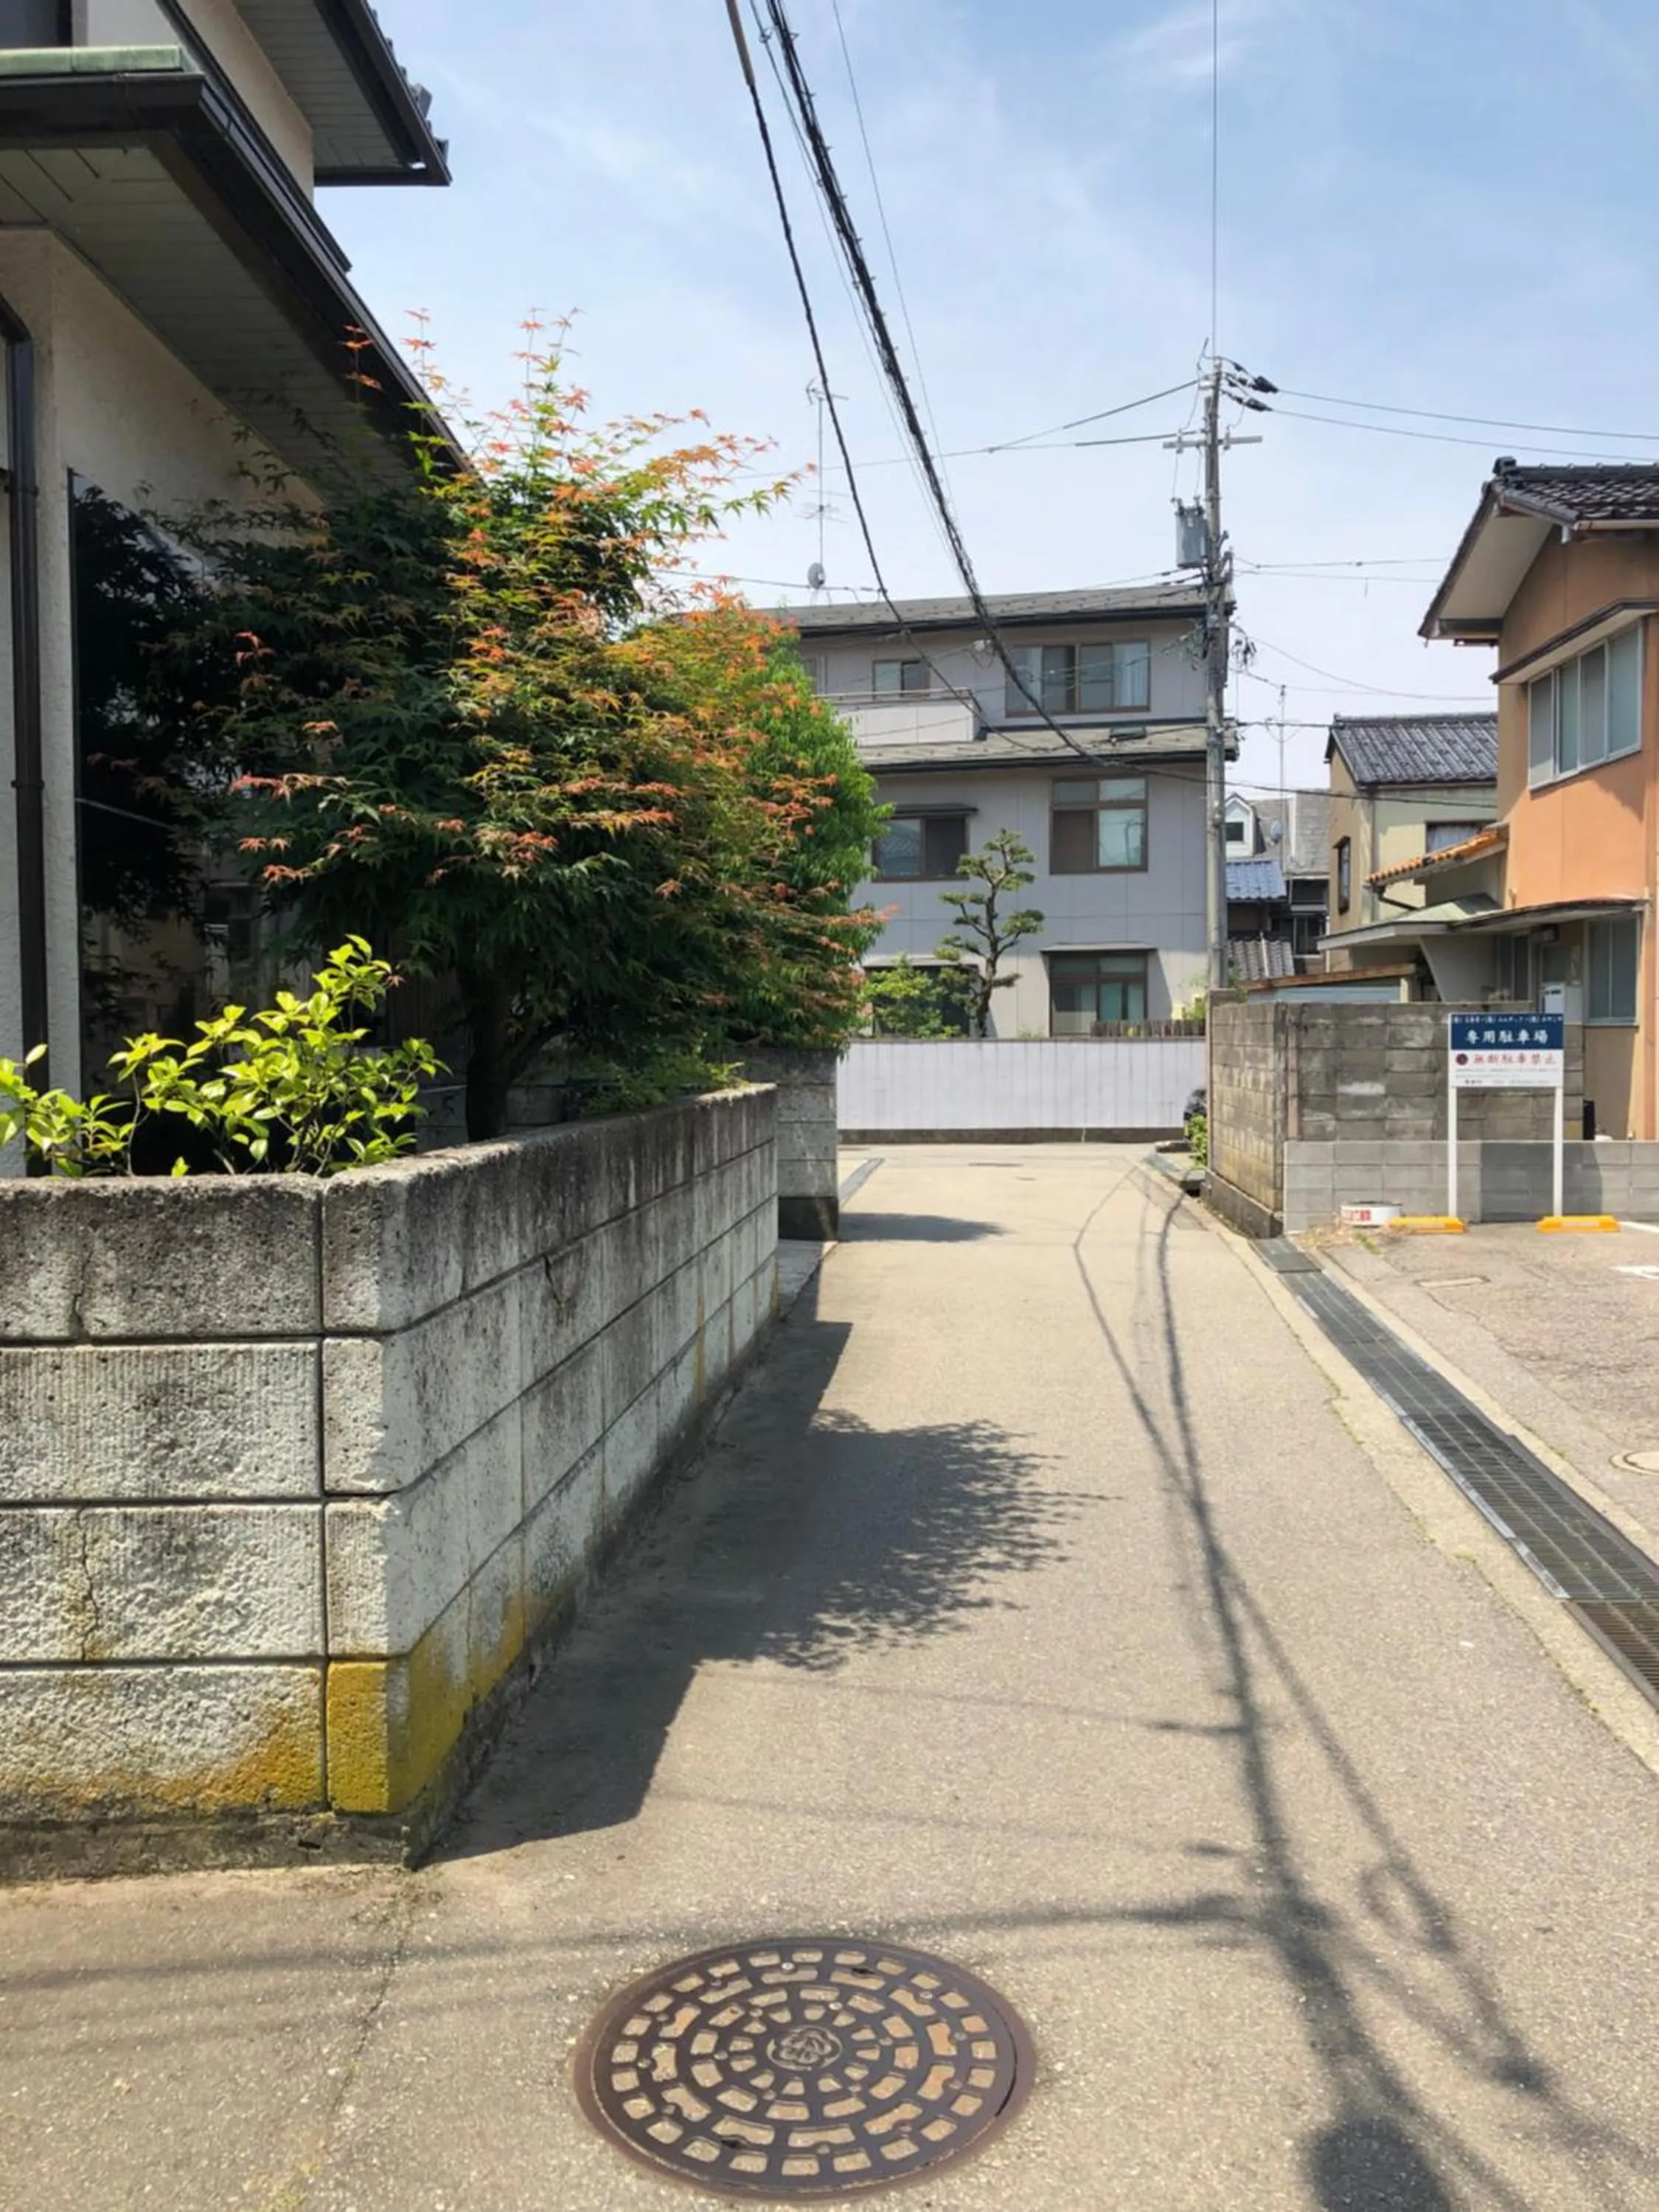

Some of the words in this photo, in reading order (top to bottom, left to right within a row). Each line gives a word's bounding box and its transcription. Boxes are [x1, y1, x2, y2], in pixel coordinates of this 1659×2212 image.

[1466, 1029, 1548, 1044] 専用駐車場
